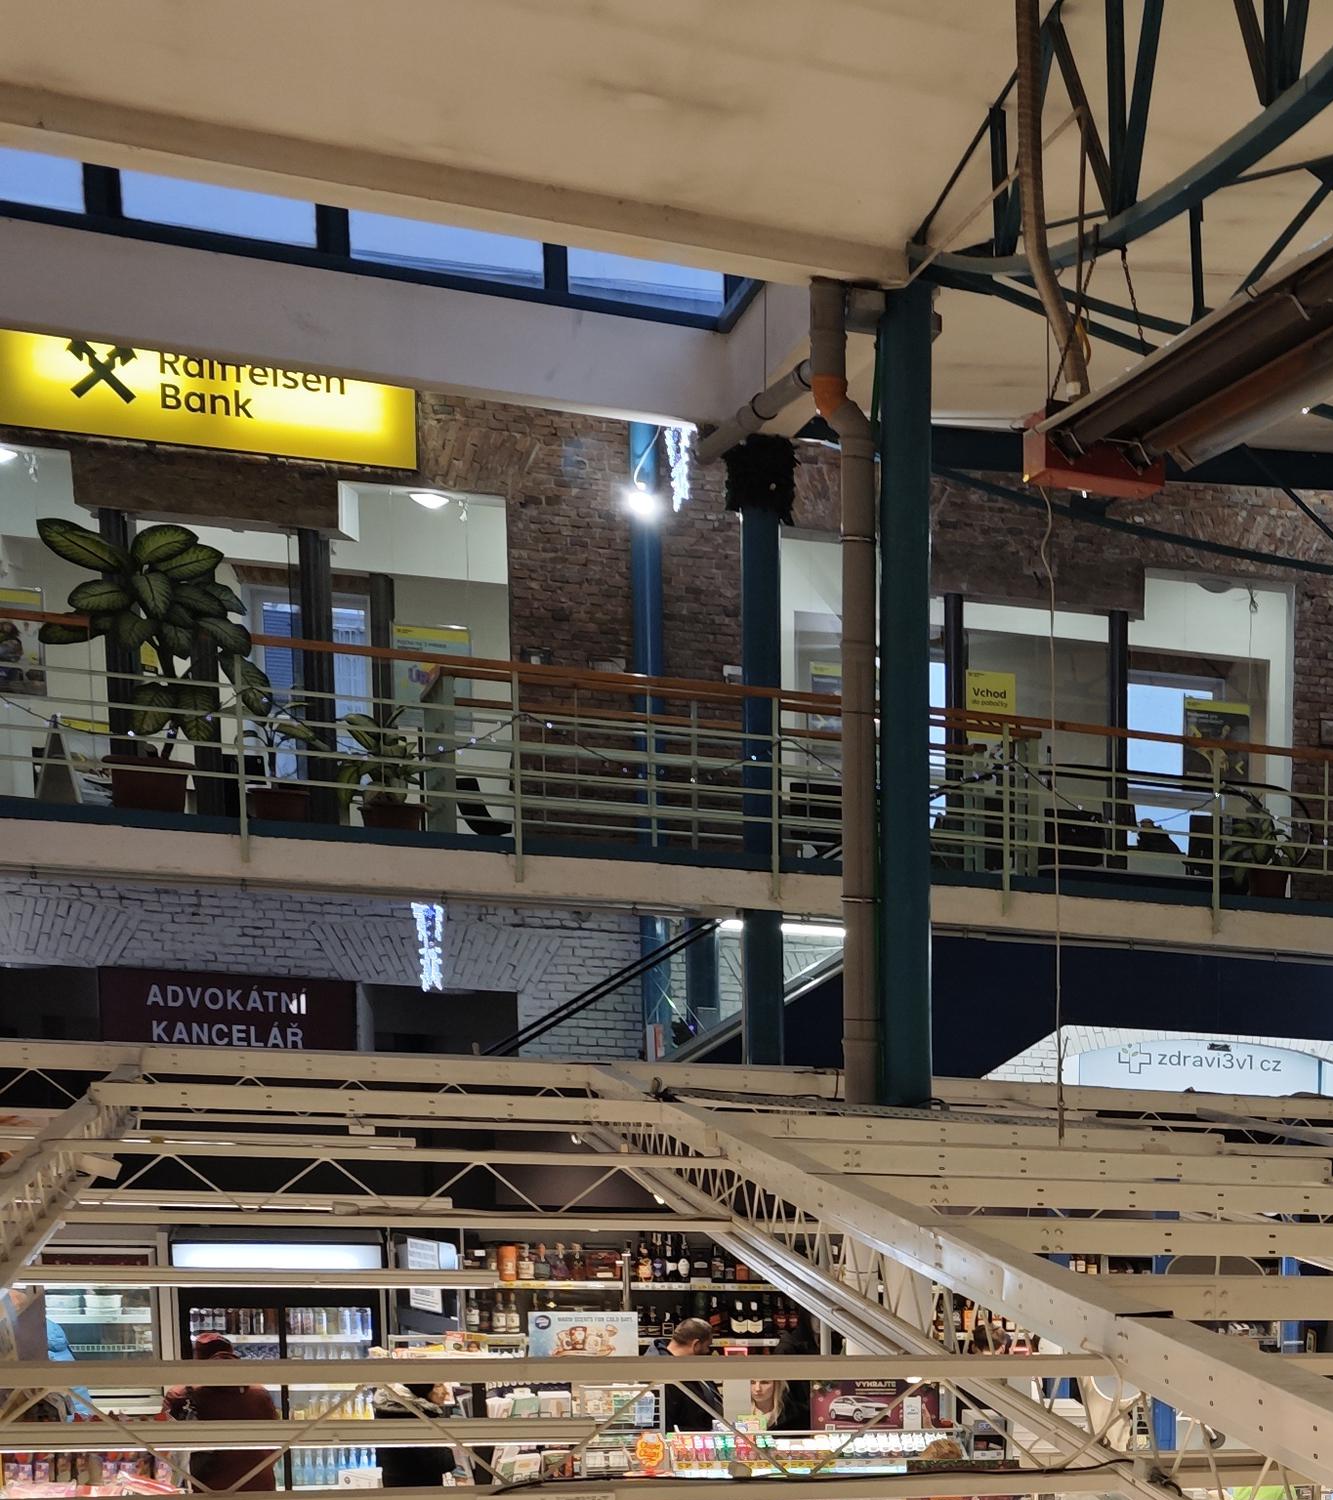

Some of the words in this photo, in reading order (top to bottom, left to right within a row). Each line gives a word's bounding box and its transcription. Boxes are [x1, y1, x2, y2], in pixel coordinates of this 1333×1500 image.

[160, 383, 254, 419] Bank
[973, 687, 1007, 699] Vchod
[146, 984, 307, 1015] ADVOKÁTNÍ
[152, 1020, 304, 1049] KANCELÁŘ
